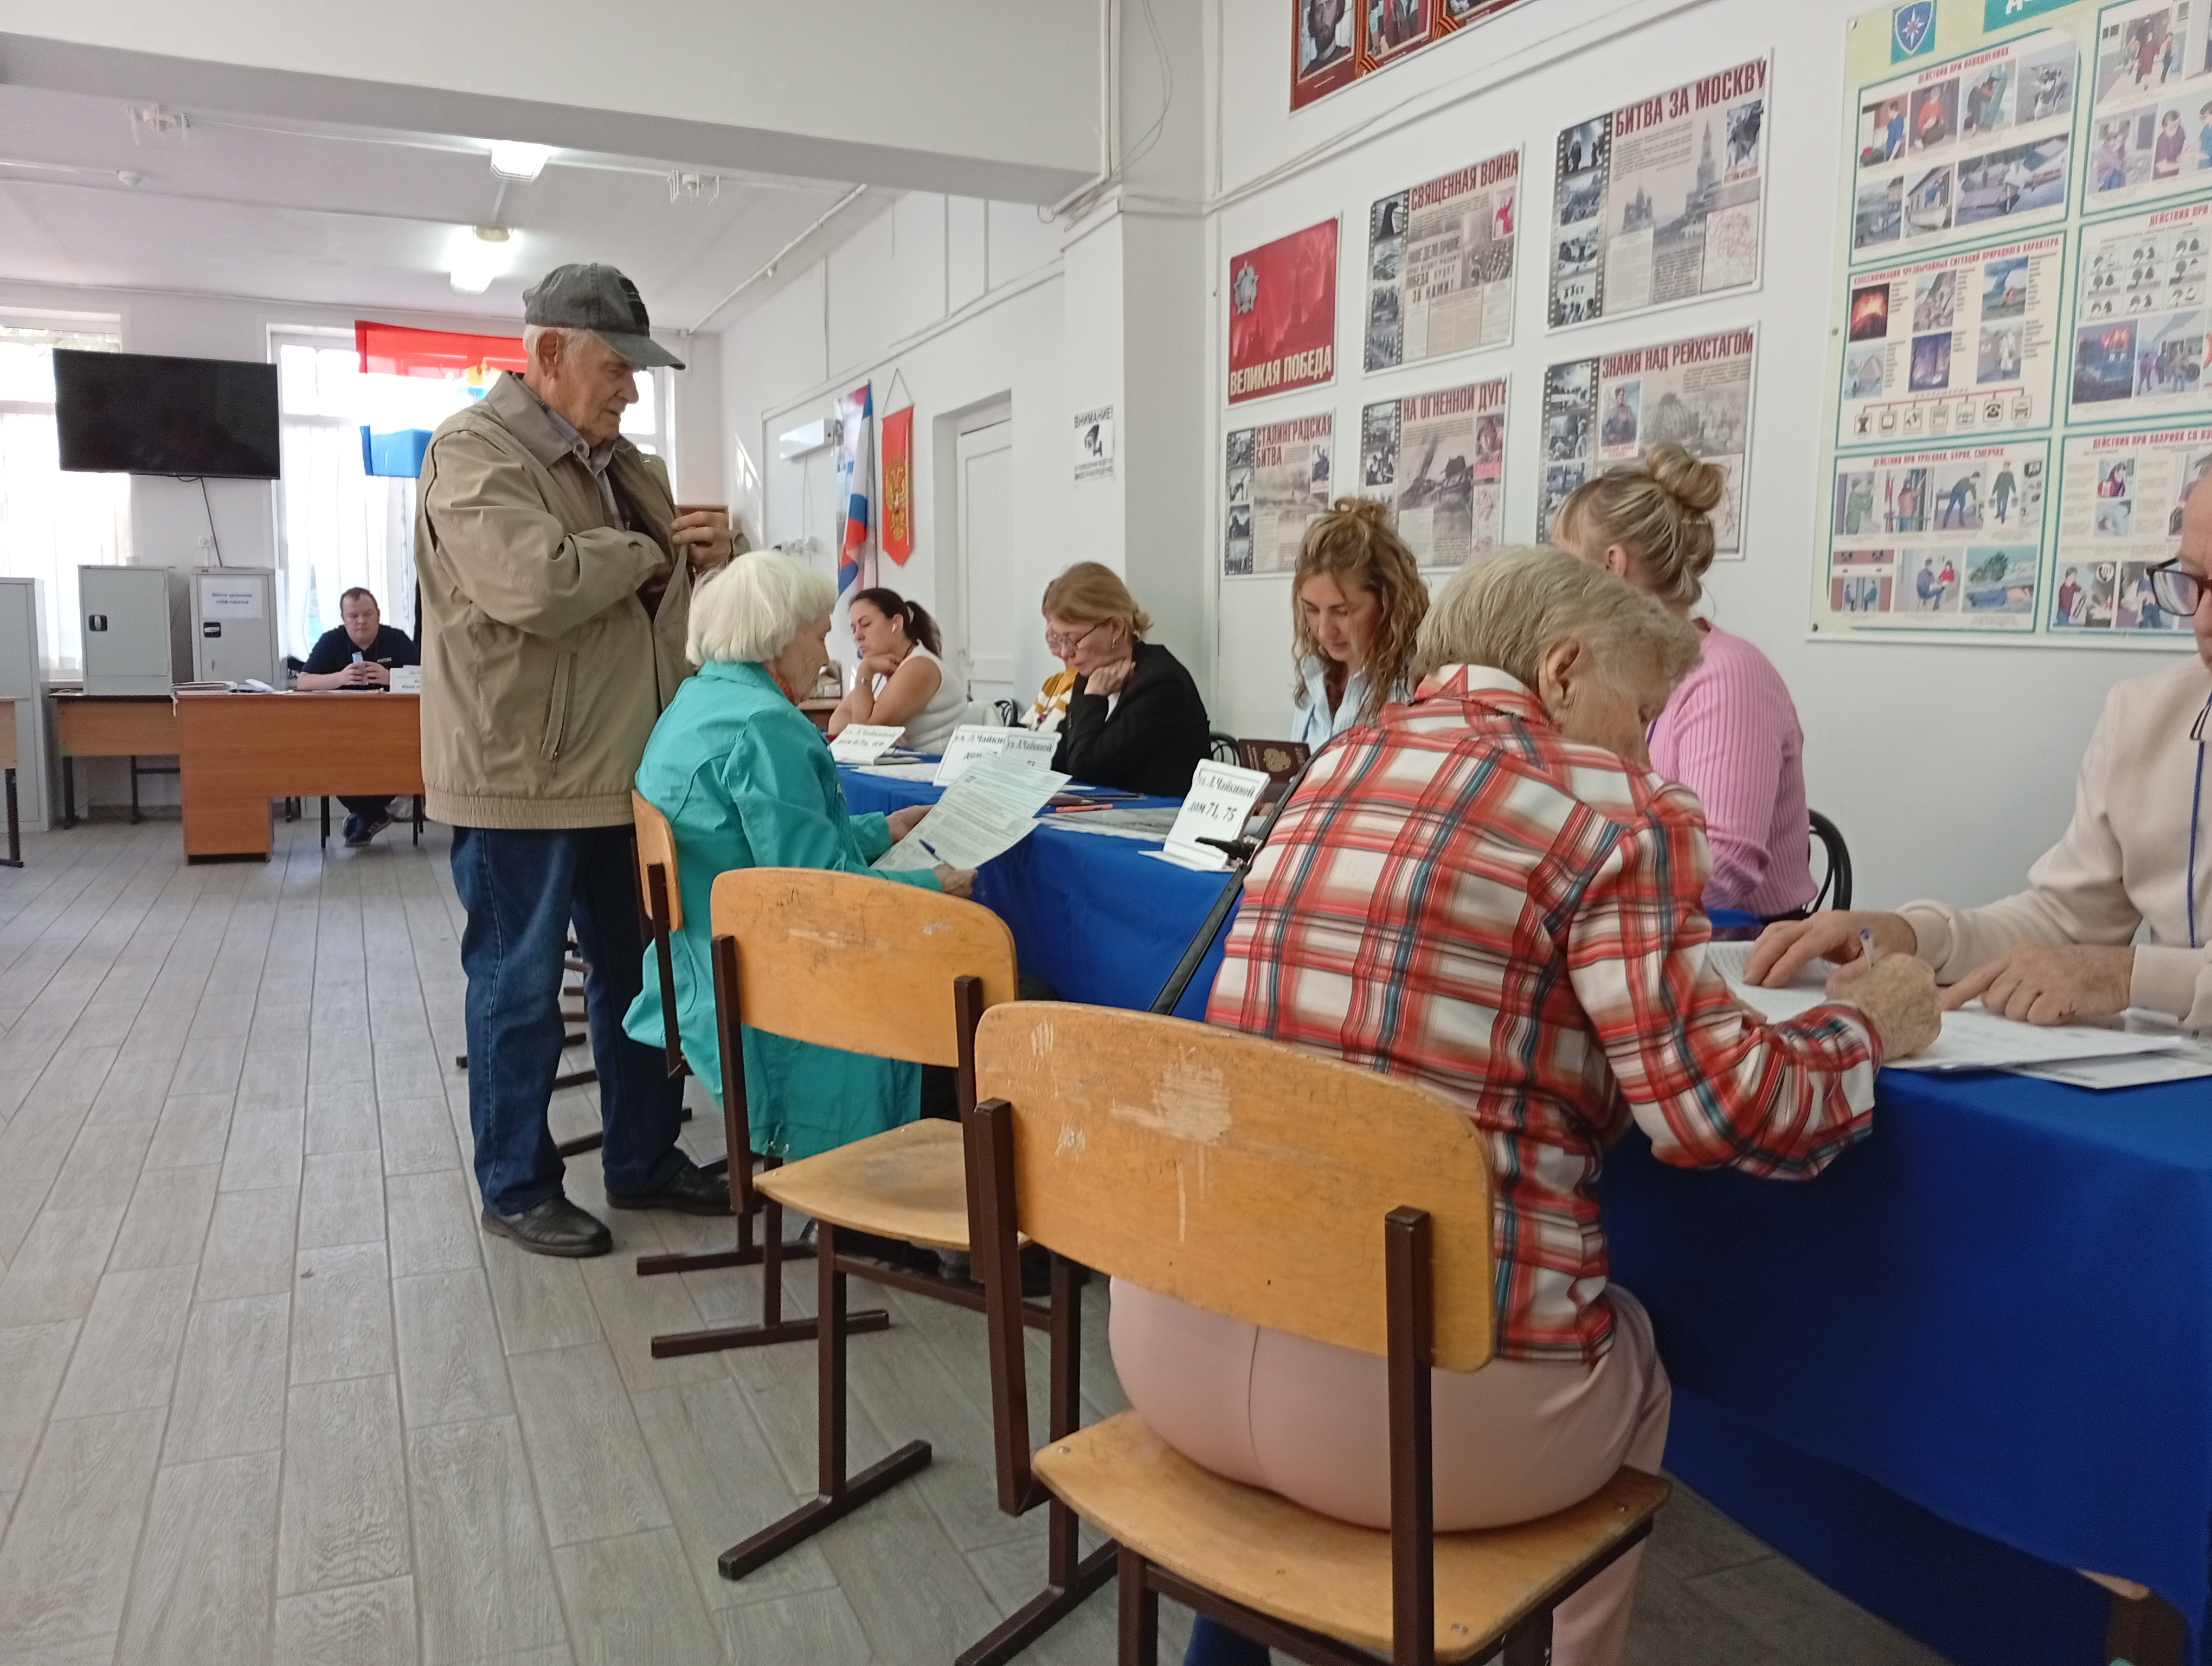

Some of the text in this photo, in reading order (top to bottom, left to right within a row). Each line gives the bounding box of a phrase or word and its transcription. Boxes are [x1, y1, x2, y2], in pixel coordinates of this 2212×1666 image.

[1950, 62, 1962, 73] ПРИ
[1616, 60, 1767, 138] БИТВА ЗА МОСКВУ
[1411, 151, 1519, 211] СВЯЩЕННАЯ ВОЙНА
[2149, 204, 2209, 227] ДЕЙСТВИЯ ПРИ
[2023, 238, 2059, 253] ХАРАКТЕРА
[1603, 332, 1753, 379] ЗНАМЯ НАД РЕЙХСТАГОМ
[1230, 345, 1332, 395] ВЕЛИКАЯ ПОБЕДА
[1404, 399, 1416, 422] НА
[1420, 385, 1475, 419] ОГНЕННОЙ
[1075, 406, 1113, 428] ВНИМАНИЕ!
[1256, 414, 1332, 447] СТАЛИНГРАДСКАЯ
[2132, 434, 2146, 445] ПРИ
[1256, 445, 1282, 468] БИТВА
[954, 734, 965, 742] ул.
[962, 751, 982, 760] дом
[1187, 800, 1238, 822] дом 71, 75
